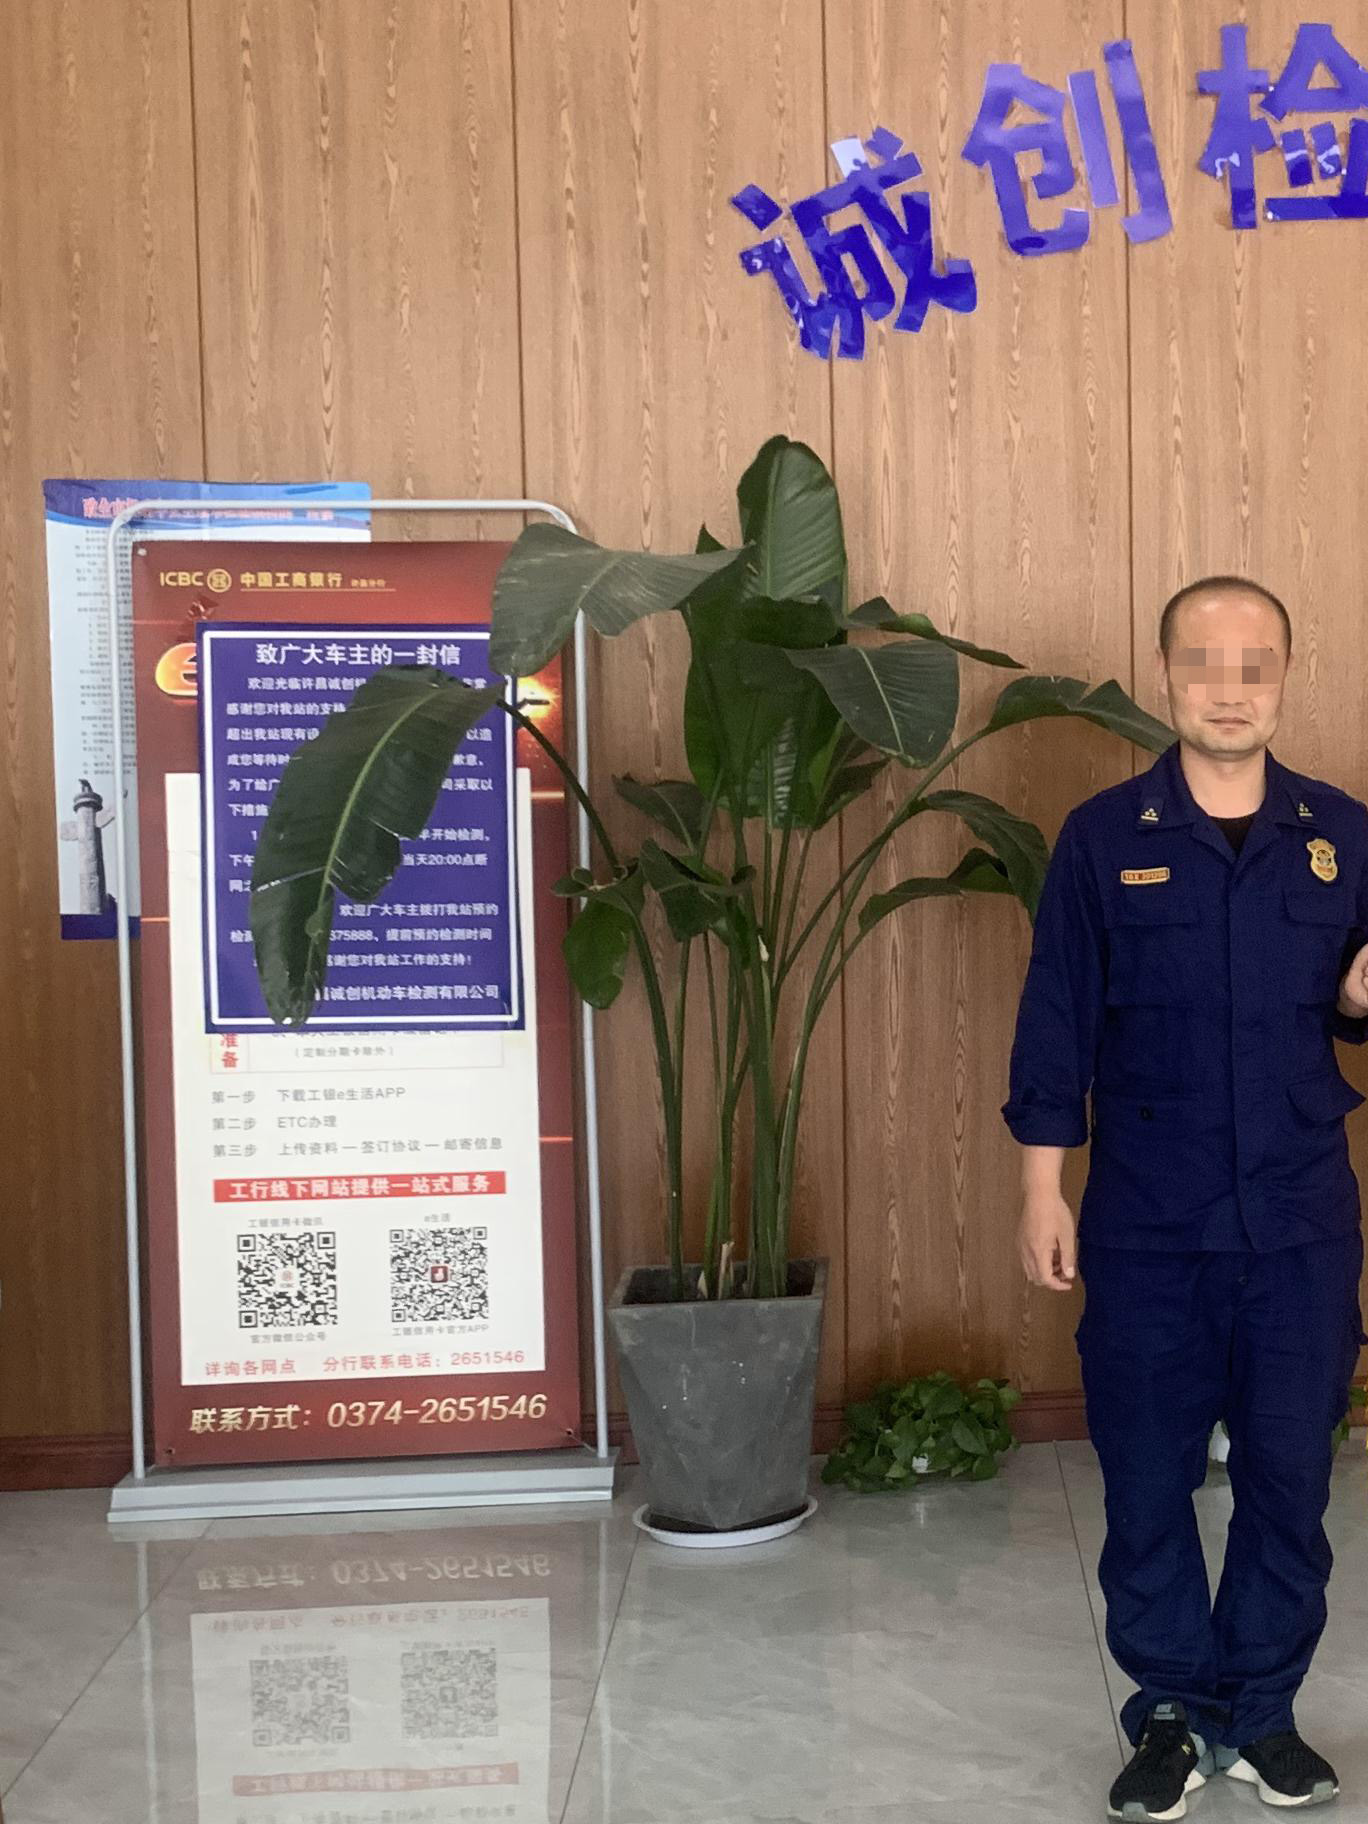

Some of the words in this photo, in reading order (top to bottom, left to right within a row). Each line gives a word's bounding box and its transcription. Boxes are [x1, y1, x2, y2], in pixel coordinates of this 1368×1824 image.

[159, 571, 204, 587] ICBC
[240, 571, 343, 588] 中国工商银行
[256, 643, 461, 665] 致广大车主的一封信
[315, 984, 499, 1001] 诚创机动车检测有限公司
[211, 1089, 256, 1104] 第一步
[277, 1086, 406, 1103] 下载工银e生活APP
[211, 1116, 257, 1131] 第二步
[277, 1114, 338, 1129] ETC办理
[212, 1143, 257, 1158] 第三步
[229, 1174, 491, 1199] 工行线下网站提供一站式服务
[205, 1358, 297, 1377] 详询各网点
